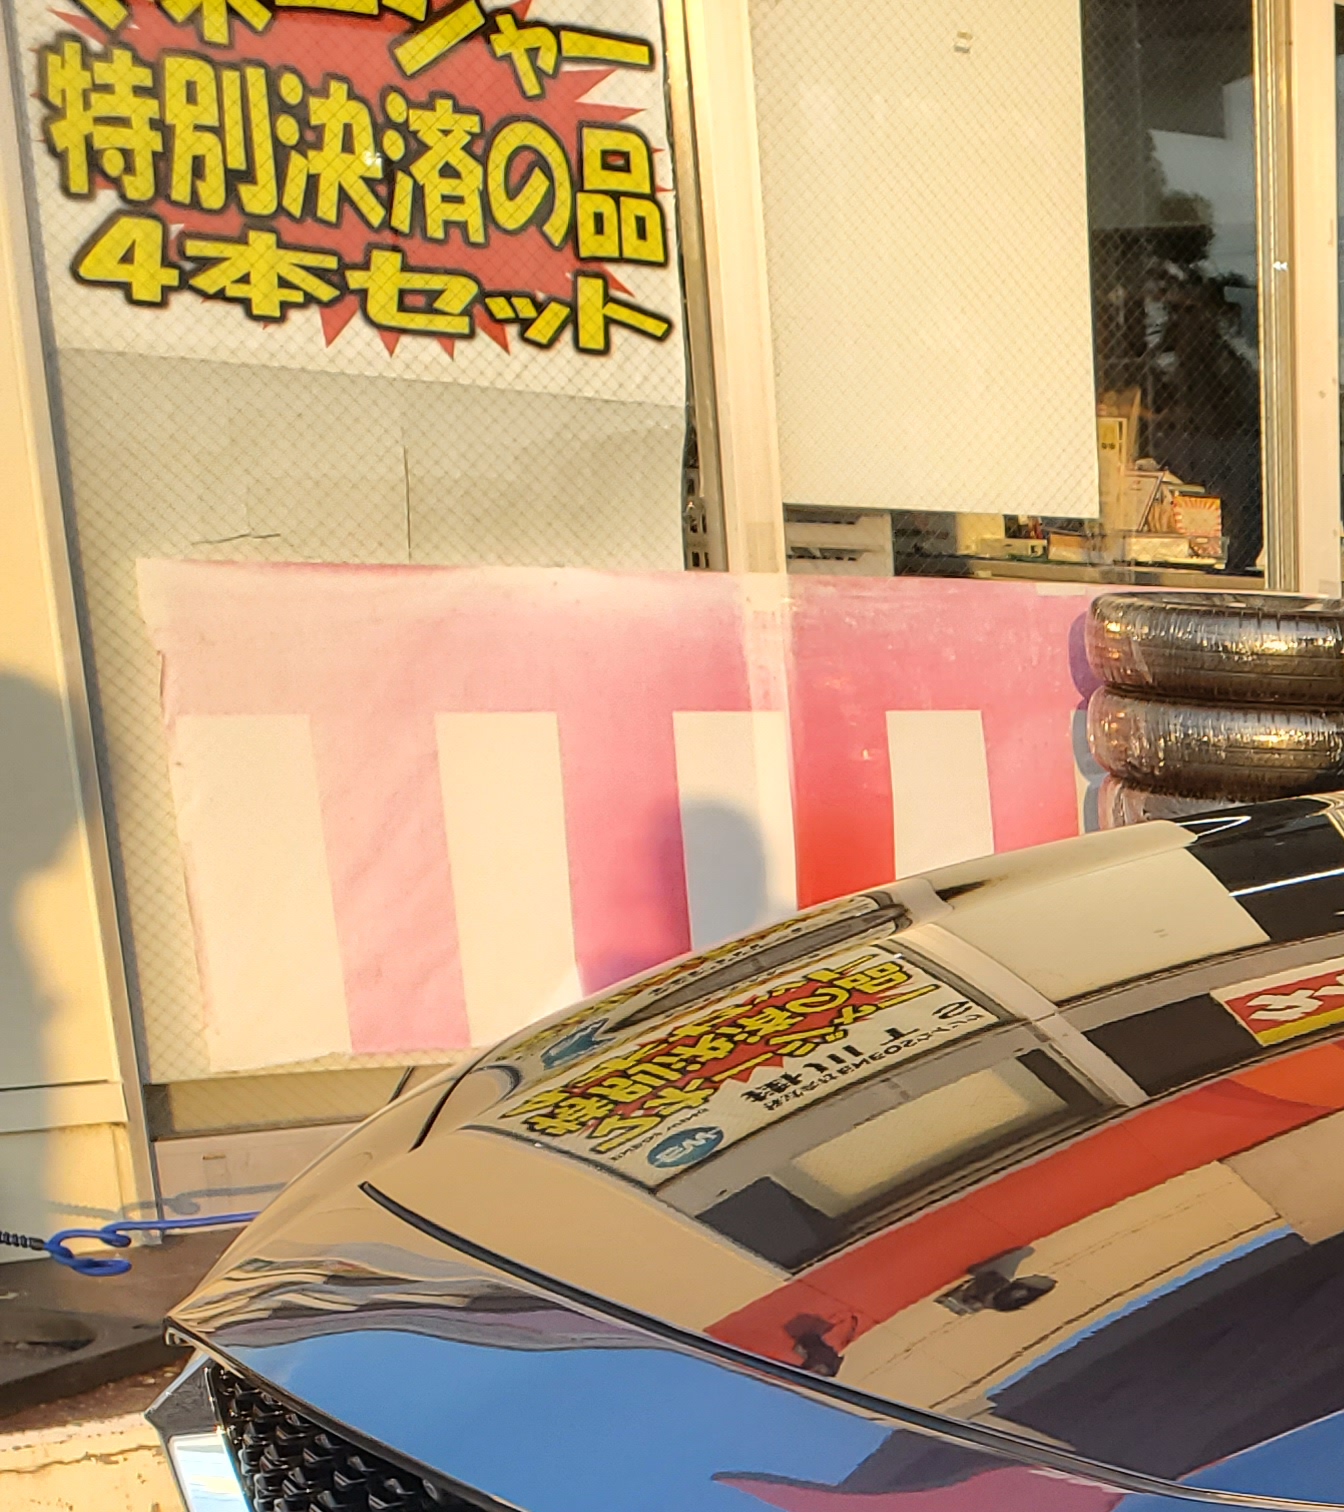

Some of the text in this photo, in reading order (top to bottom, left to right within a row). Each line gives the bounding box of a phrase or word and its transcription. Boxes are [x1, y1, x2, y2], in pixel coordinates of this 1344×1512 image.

[40, 38, 670, 268] 特別決済の品
[73, 213, 674, 355] 4本セット
